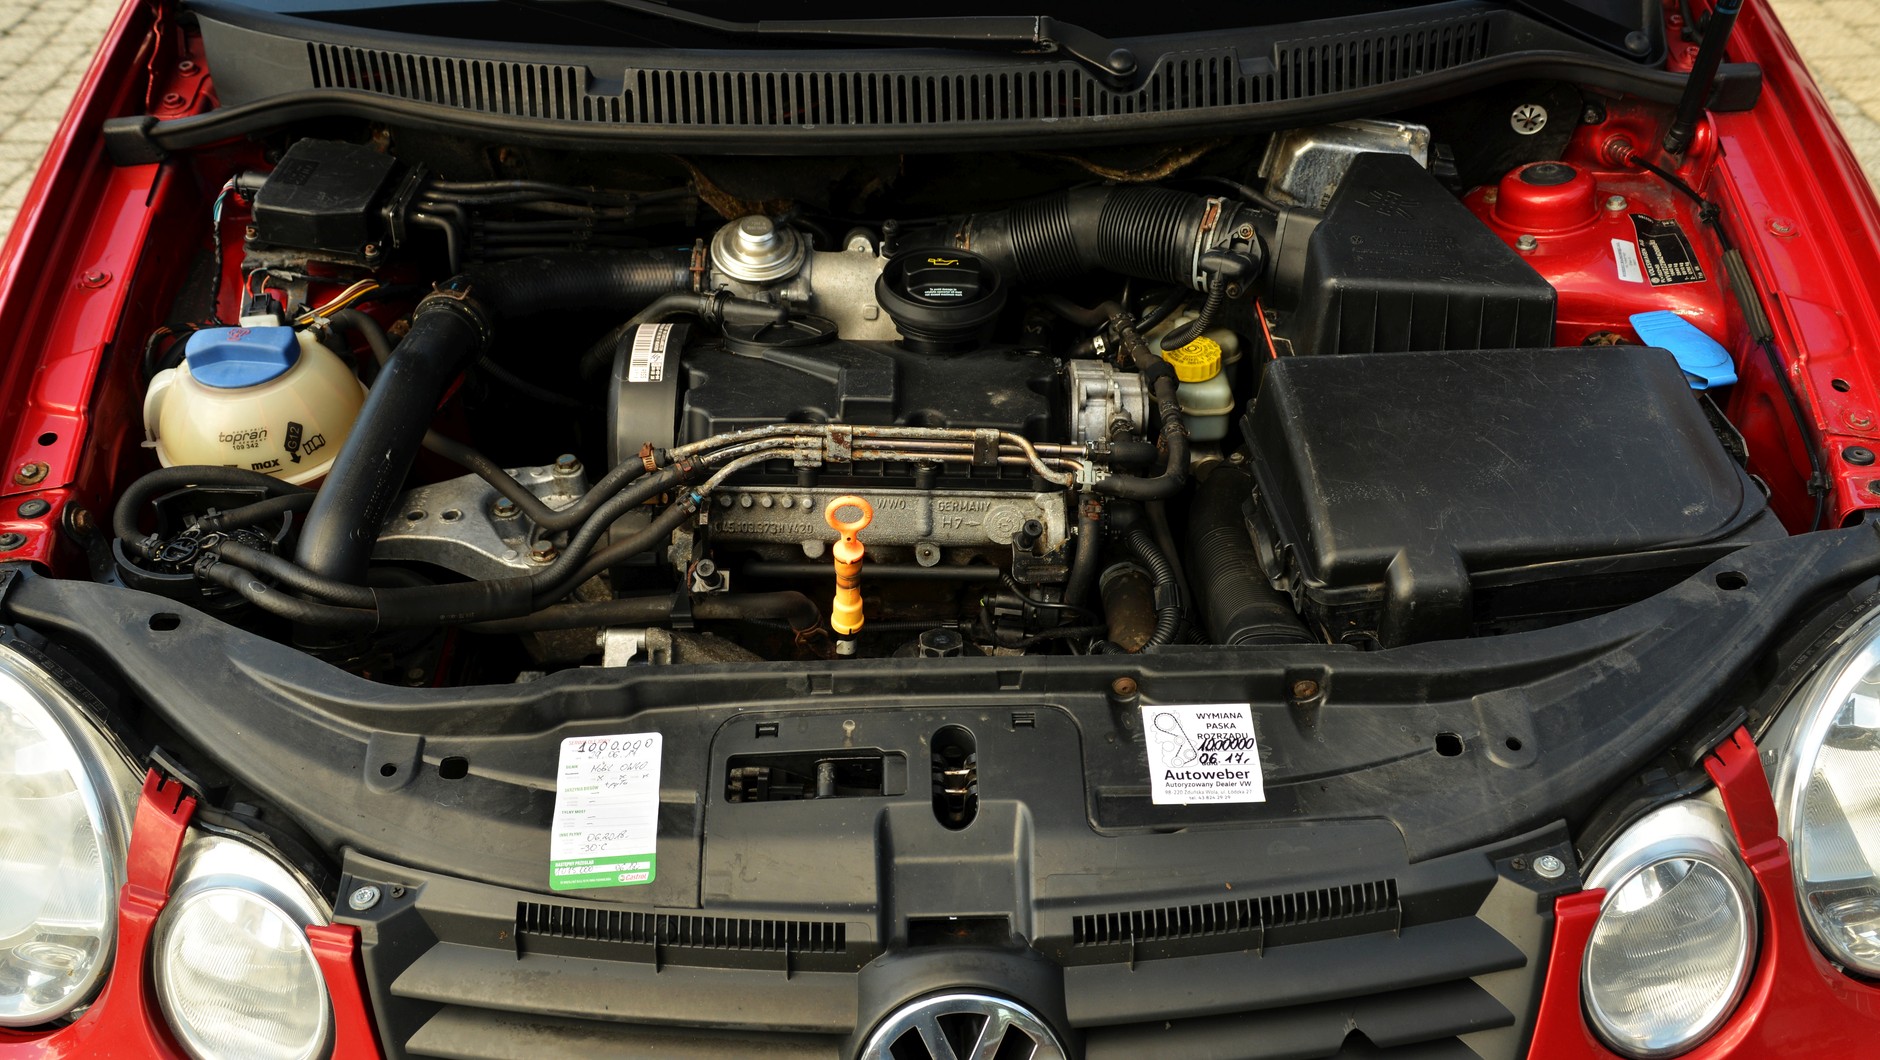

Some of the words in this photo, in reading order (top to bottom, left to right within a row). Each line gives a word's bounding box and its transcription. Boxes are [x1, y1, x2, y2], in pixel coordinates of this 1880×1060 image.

[218, 430, 268, 445] topran
[287, 426, 300, 450] G12
[251, 459, 280, 471] max
[938, 500, 992, 512] GERMANY
[942, 516, 964, 530] H7
[1197, 738, 1254, 752] 1000000
[1165, 768, 1250, 780] Autoweber
[625, 872, 646, 881] Castrol
